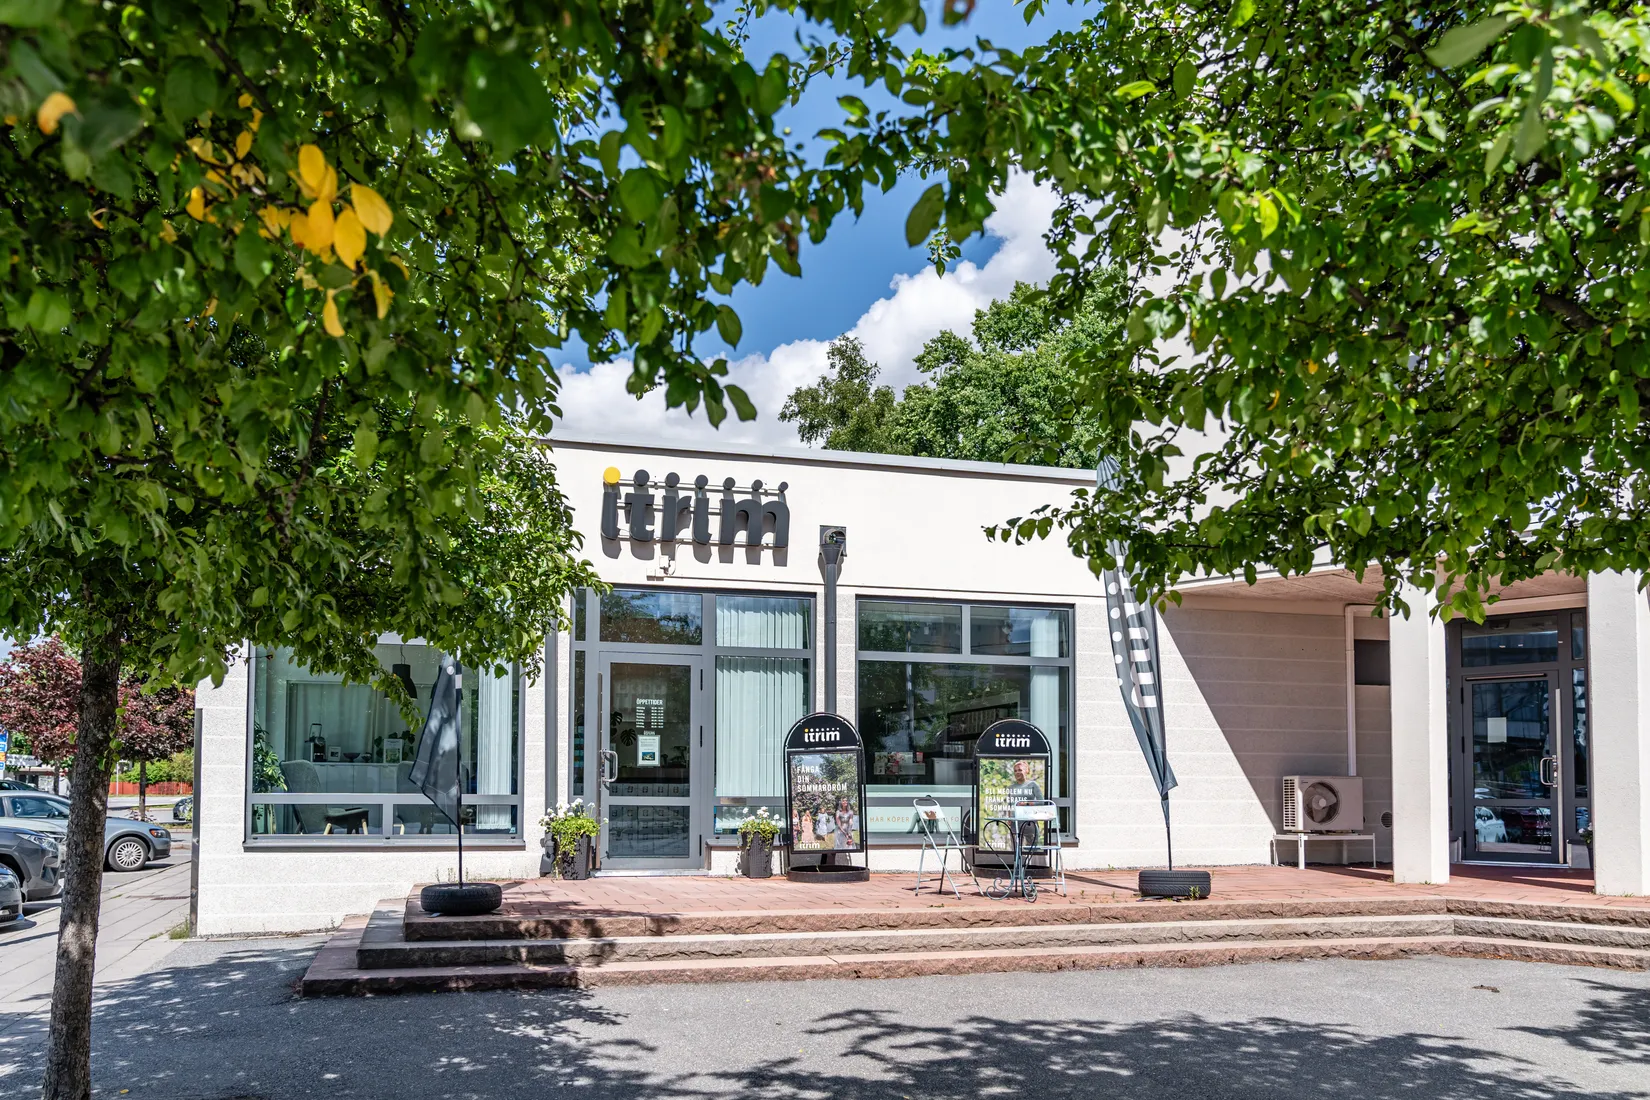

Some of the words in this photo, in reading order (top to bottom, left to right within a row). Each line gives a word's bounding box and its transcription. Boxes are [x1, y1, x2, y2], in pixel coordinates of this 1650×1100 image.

[601, 466, 790, 548] itrim
[636, 698, 663, 706] ÖPPETTIDER
[804, 727, 840, 743] itrim
[995, 733, 1031, 748] itrim
[796, 764, 820, 774] FÅNGA
[797, 775, 810, 783] DIN
[797, 781, 848, 792] SOMMARDRÖM
[985, 788, 996, 796] BLI
[997, 788, 1022, 796] MEDLEM
[1024, 788, 1033, 796] NU
[887, 815, 910, 823] KÖPER
